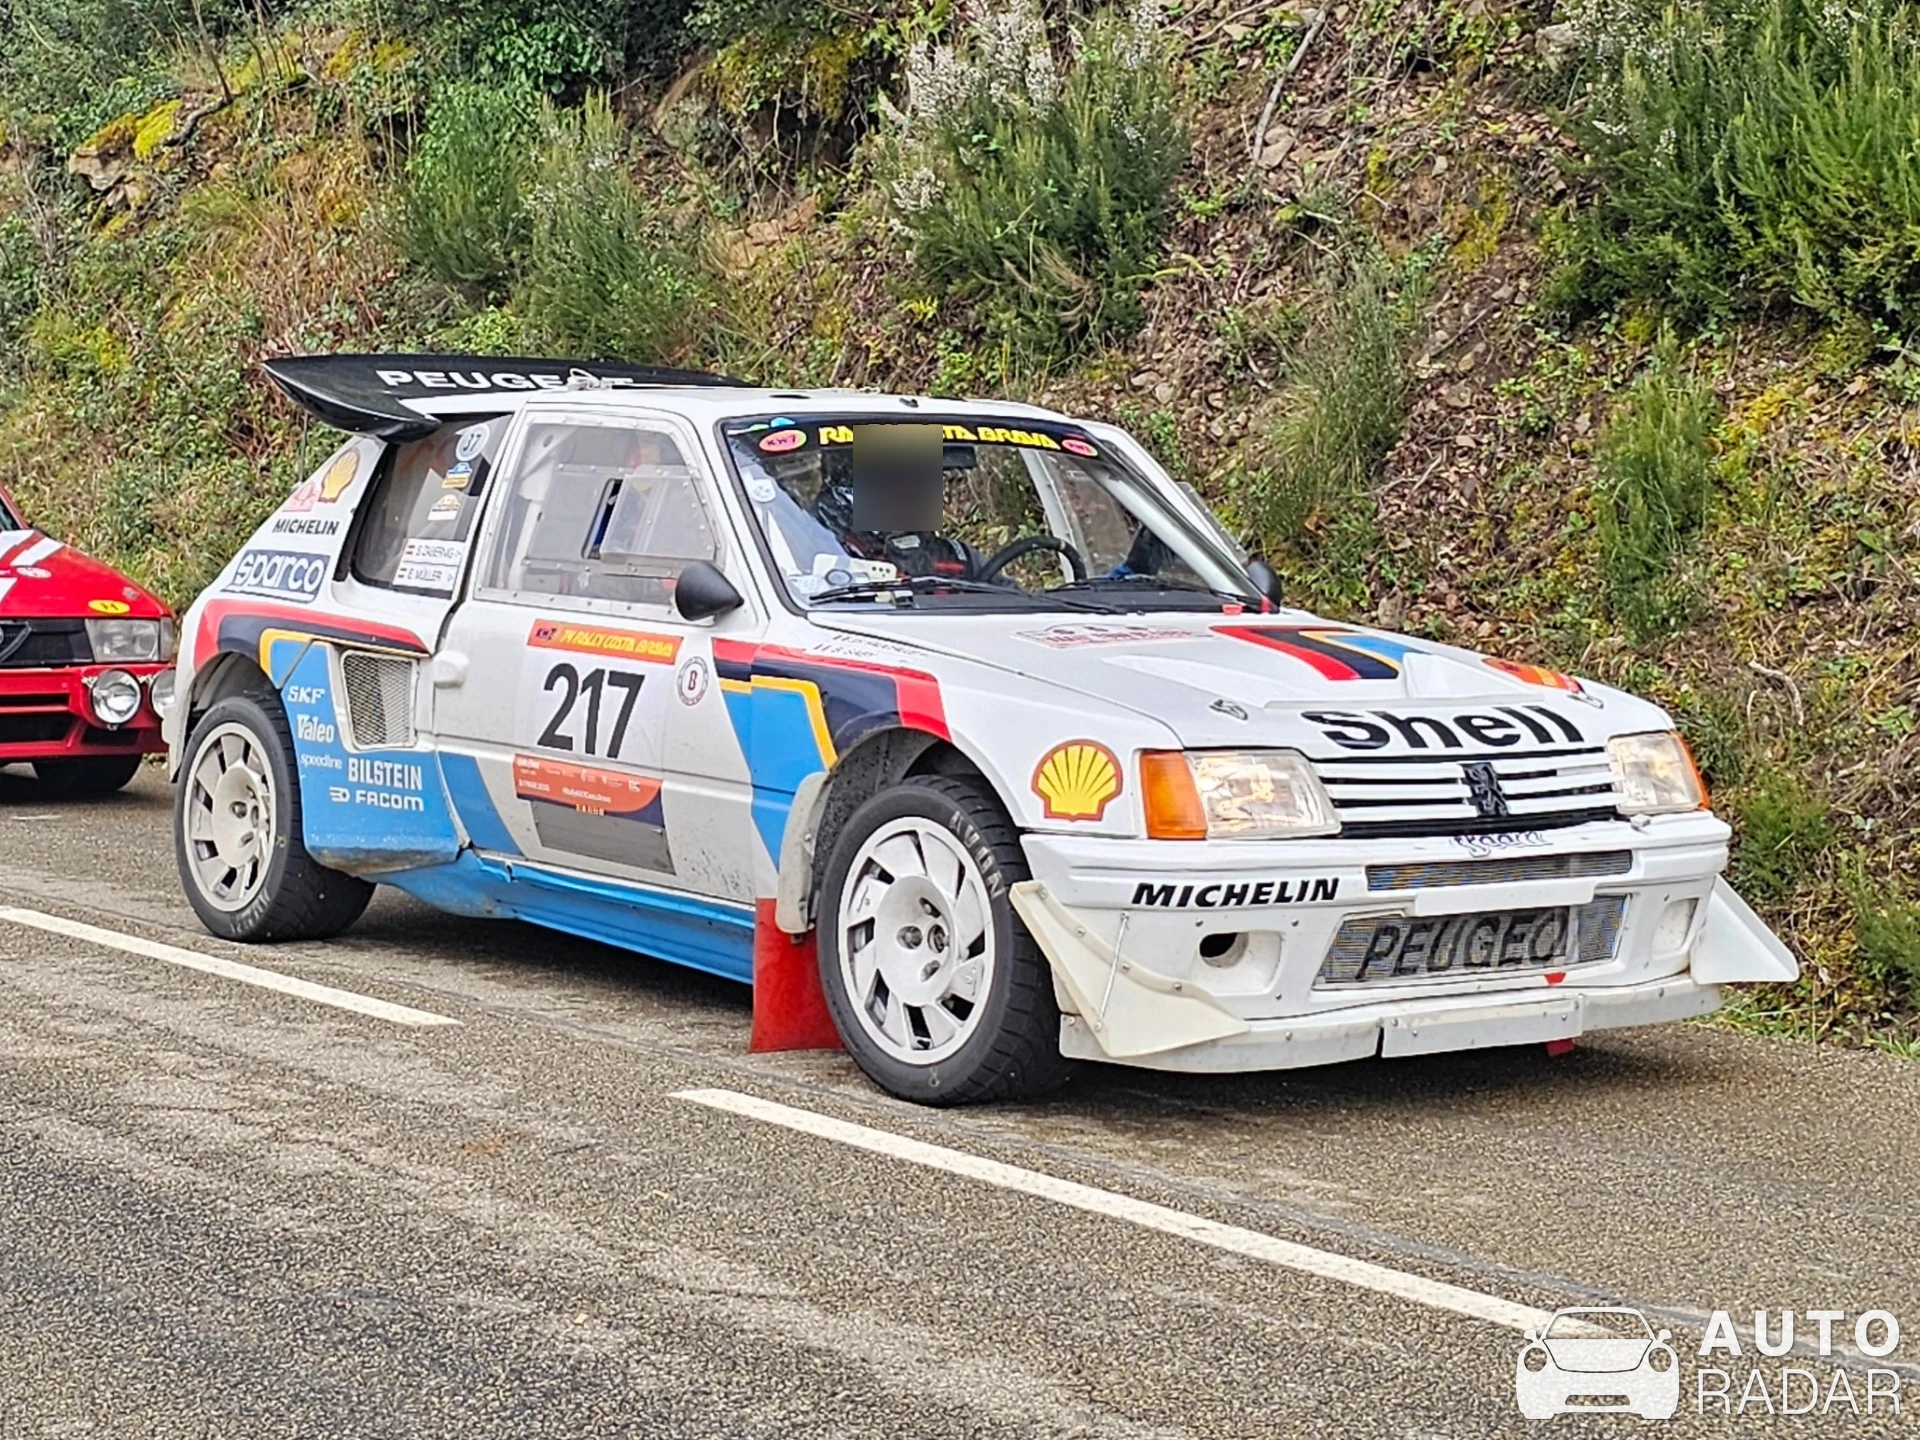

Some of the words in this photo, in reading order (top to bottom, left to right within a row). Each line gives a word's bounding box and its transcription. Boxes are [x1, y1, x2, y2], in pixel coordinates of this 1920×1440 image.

[977, 426, 1061, 450] BRAVA
[272, 518, 340, 536] MICHELIN
[233, 552, 326, 593] sparco
[287, 685, 326, 704] SKF
[537, 662, 646, 759] 217
[1300, 705, 1584, 750] Shell
[348, 757, 423, 791] BILSTEIN
[355, 789, 425, 812] FACOM
[1131, 877, 1340, 908] MICHELIN
